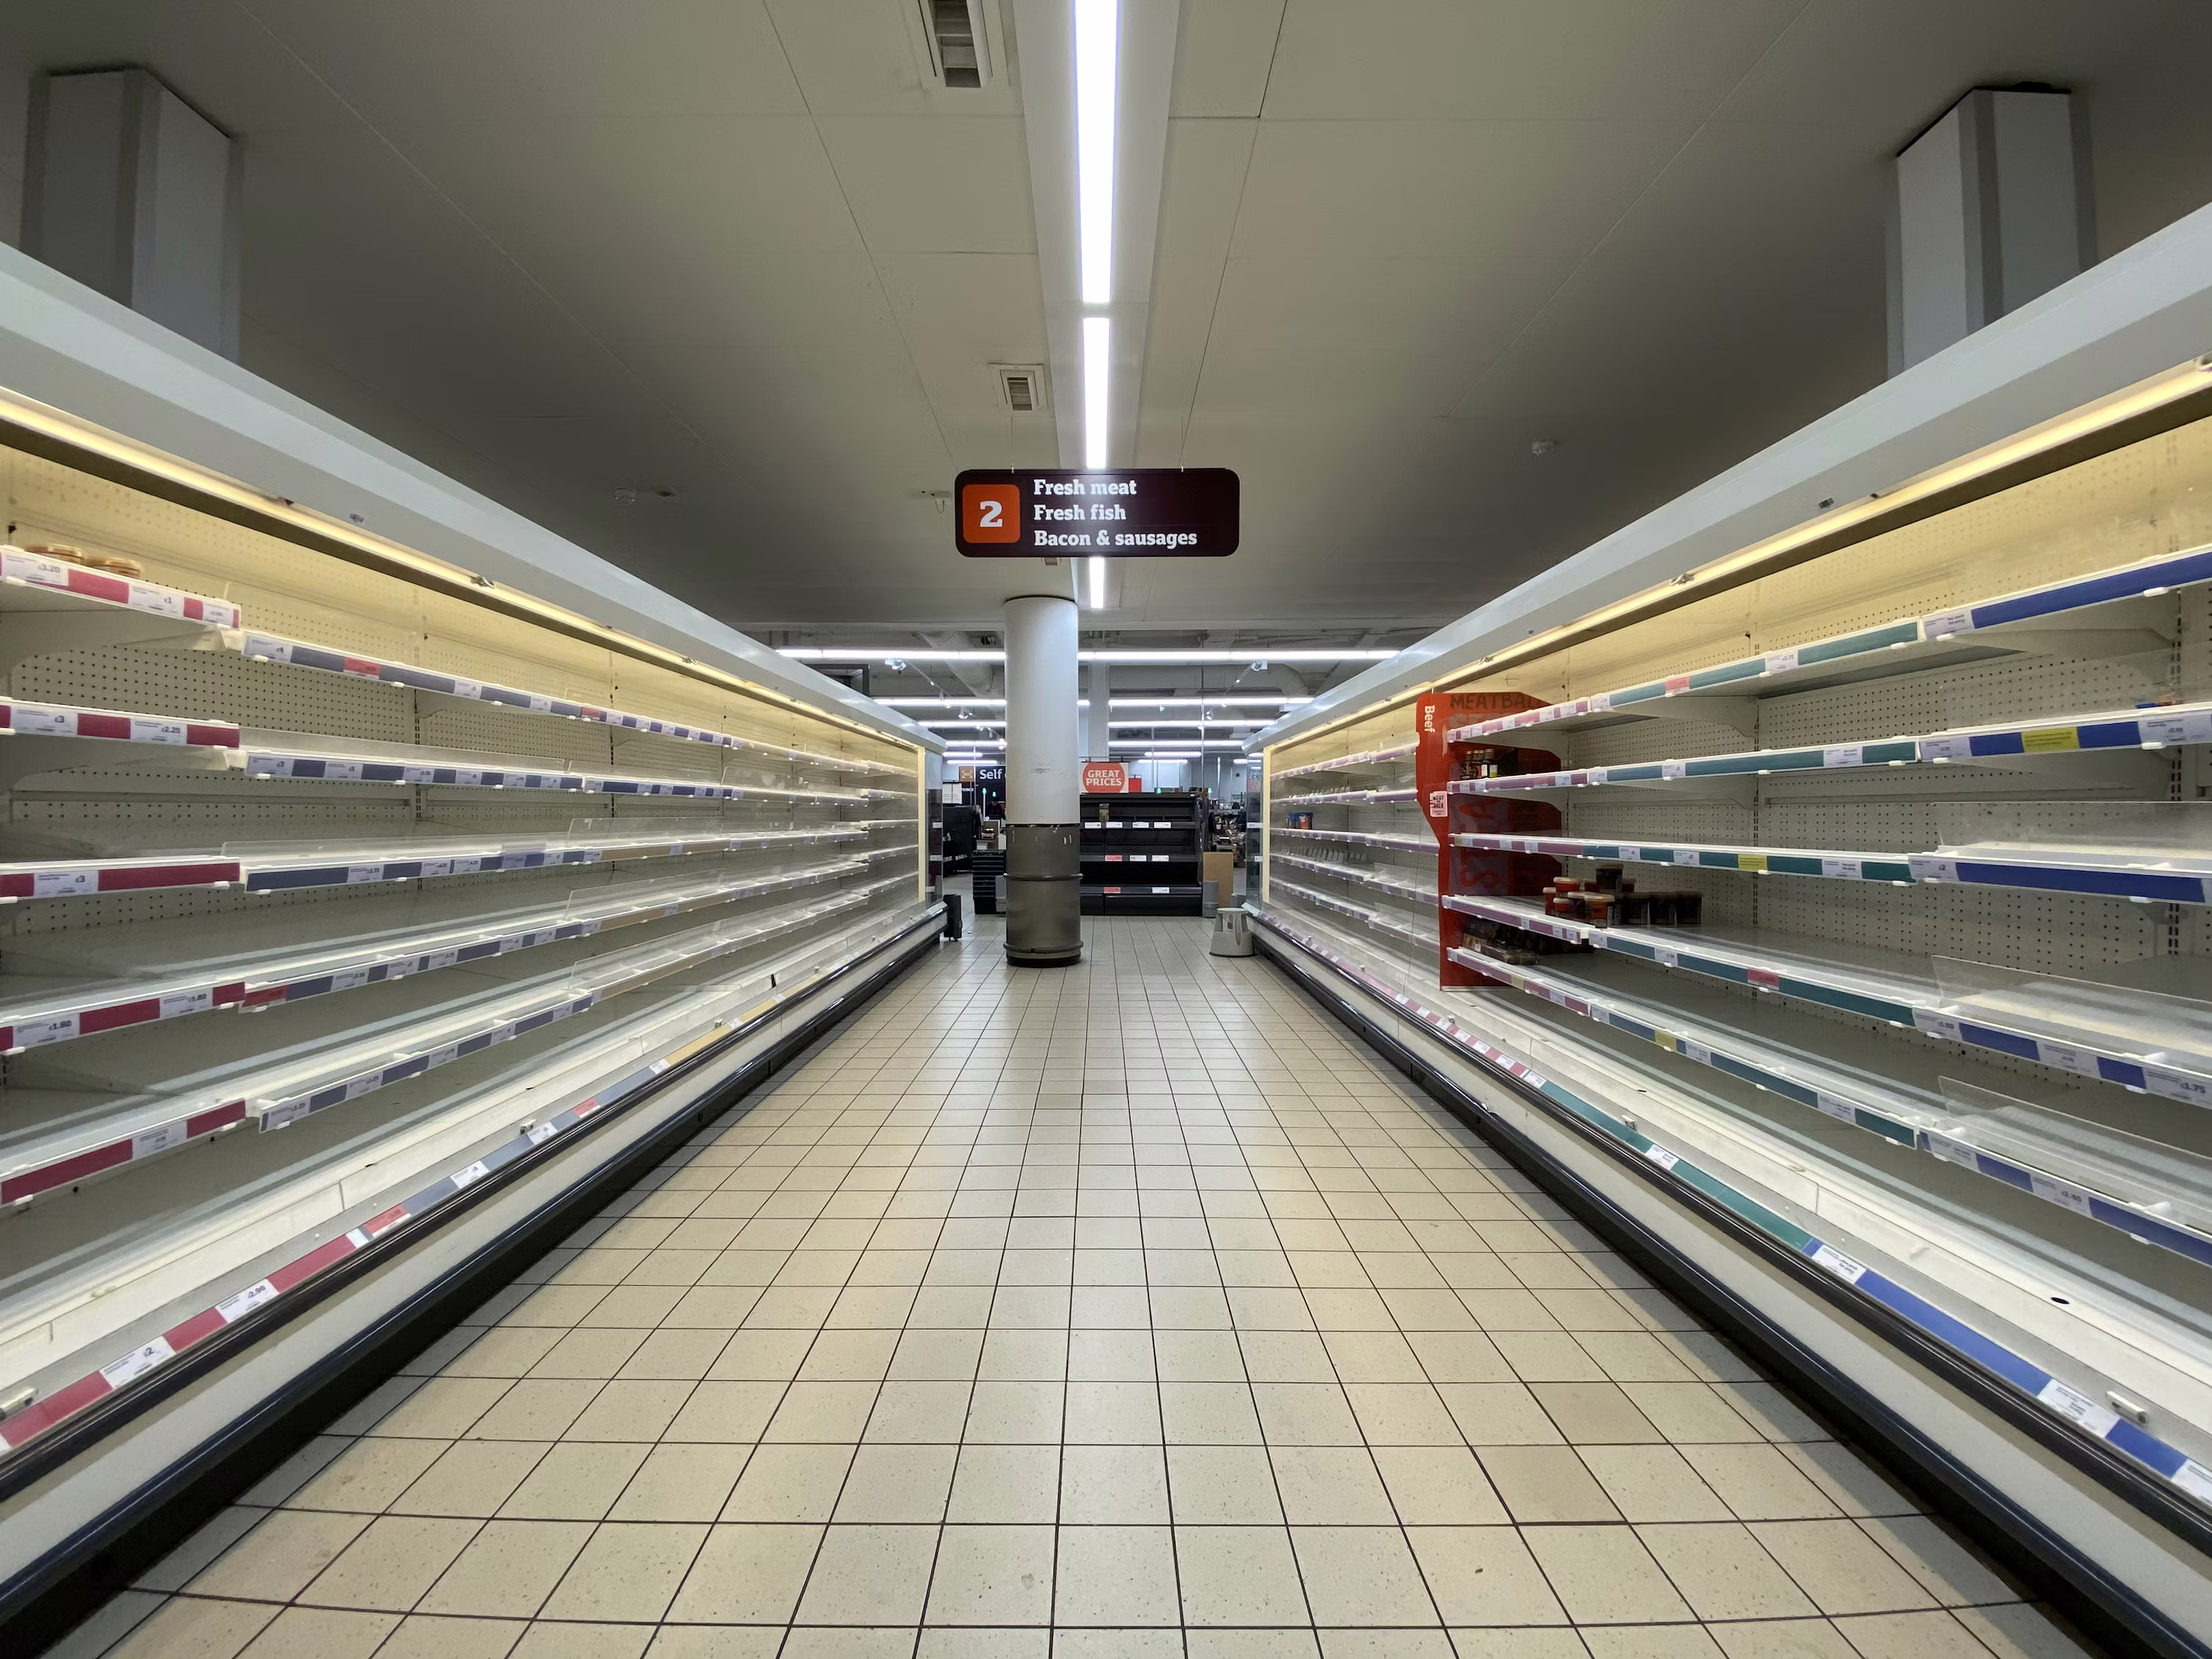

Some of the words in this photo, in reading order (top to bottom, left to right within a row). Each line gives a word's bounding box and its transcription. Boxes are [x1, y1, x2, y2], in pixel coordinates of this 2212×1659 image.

[1033, 479, 1085, 495] Fresh
[1090, 480, 1137, 495] meat
[979, 500, 1003, 527] 2
[1033, 504, 1085, 521] Fresh
[1090, 504, 1127, 521] fish
[1034, 530, 1091, 546] Bacon
[1096, 530, 1110, 546] &
[1114, 532, 1198, 549] sausages
[1424, 705, 1436, 733] Beef
[979, 769, 1003, 779] Self
[1088, 770, 1120, 778] GREAT
[1085, 779, 1122, 787] PRICES
